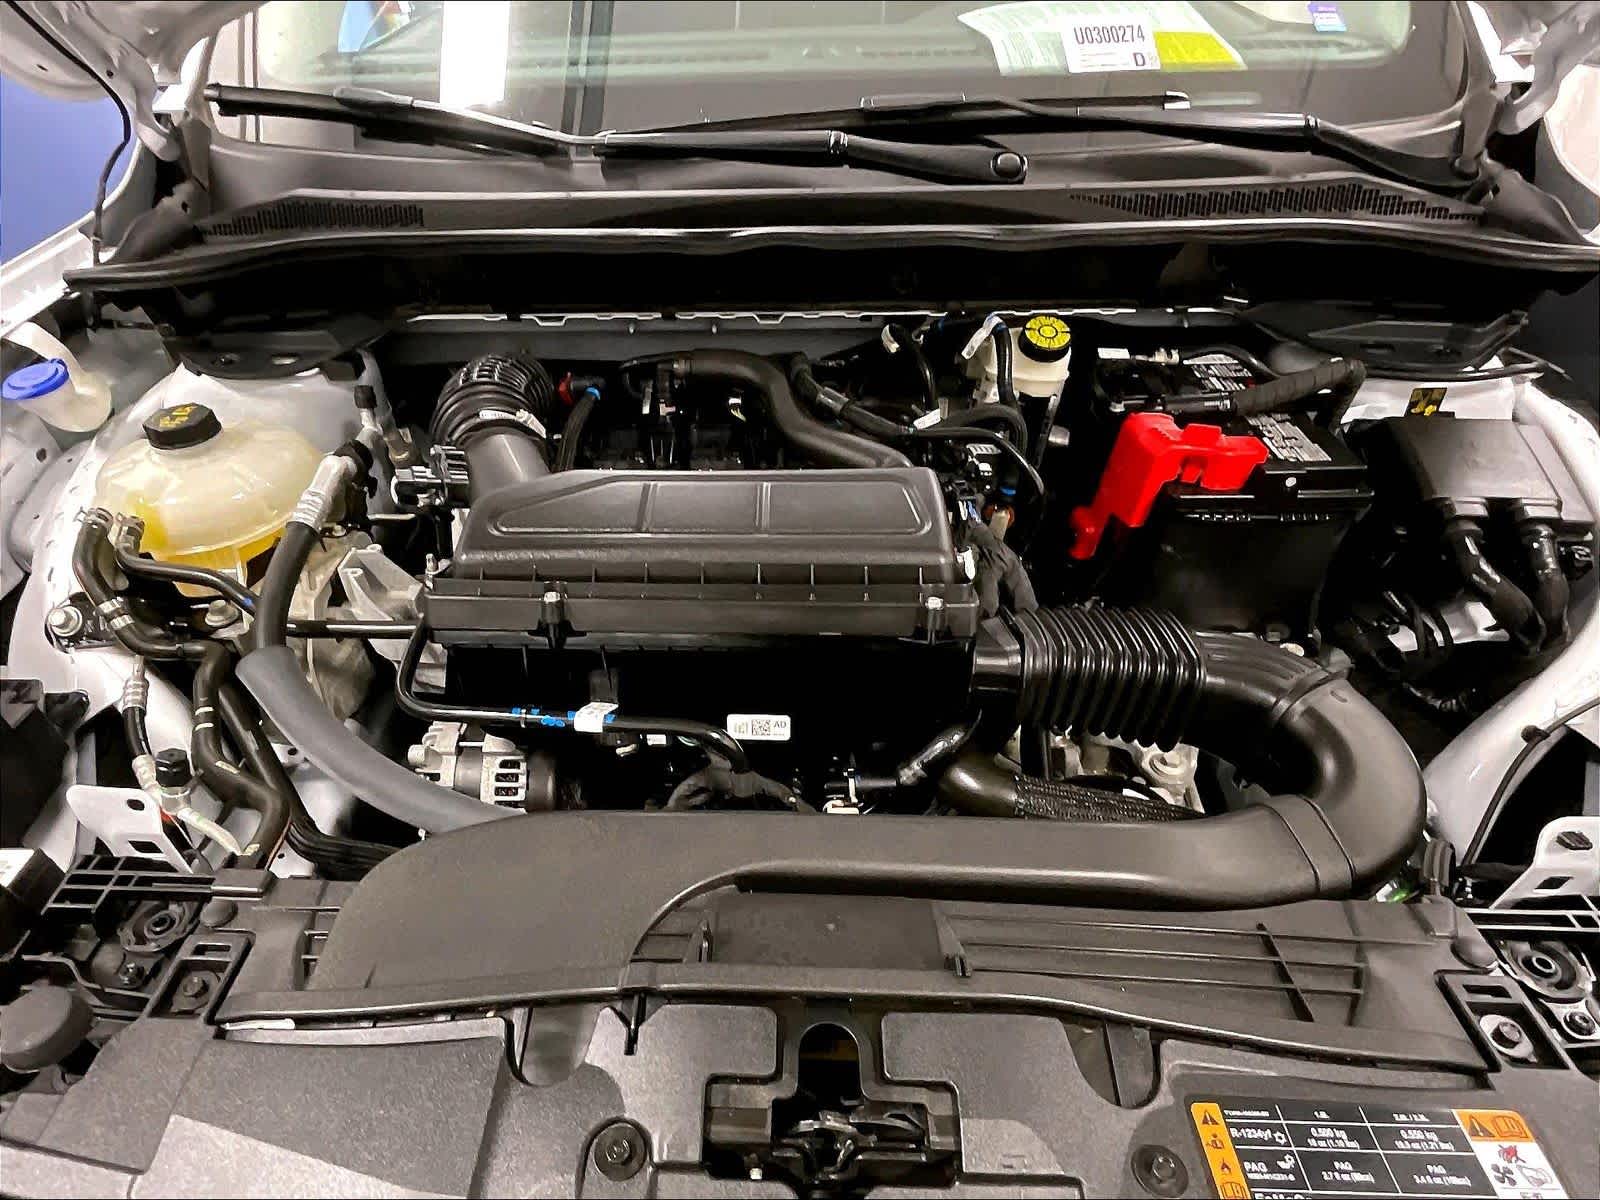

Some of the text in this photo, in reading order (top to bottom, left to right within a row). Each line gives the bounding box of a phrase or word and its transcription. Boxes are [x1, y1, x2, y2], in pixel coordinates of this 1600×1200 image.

[1073, 24, 1145, 45] U0300274
[1133, 52, 1146, 67] D
[773, 720, 787, 729] AD
